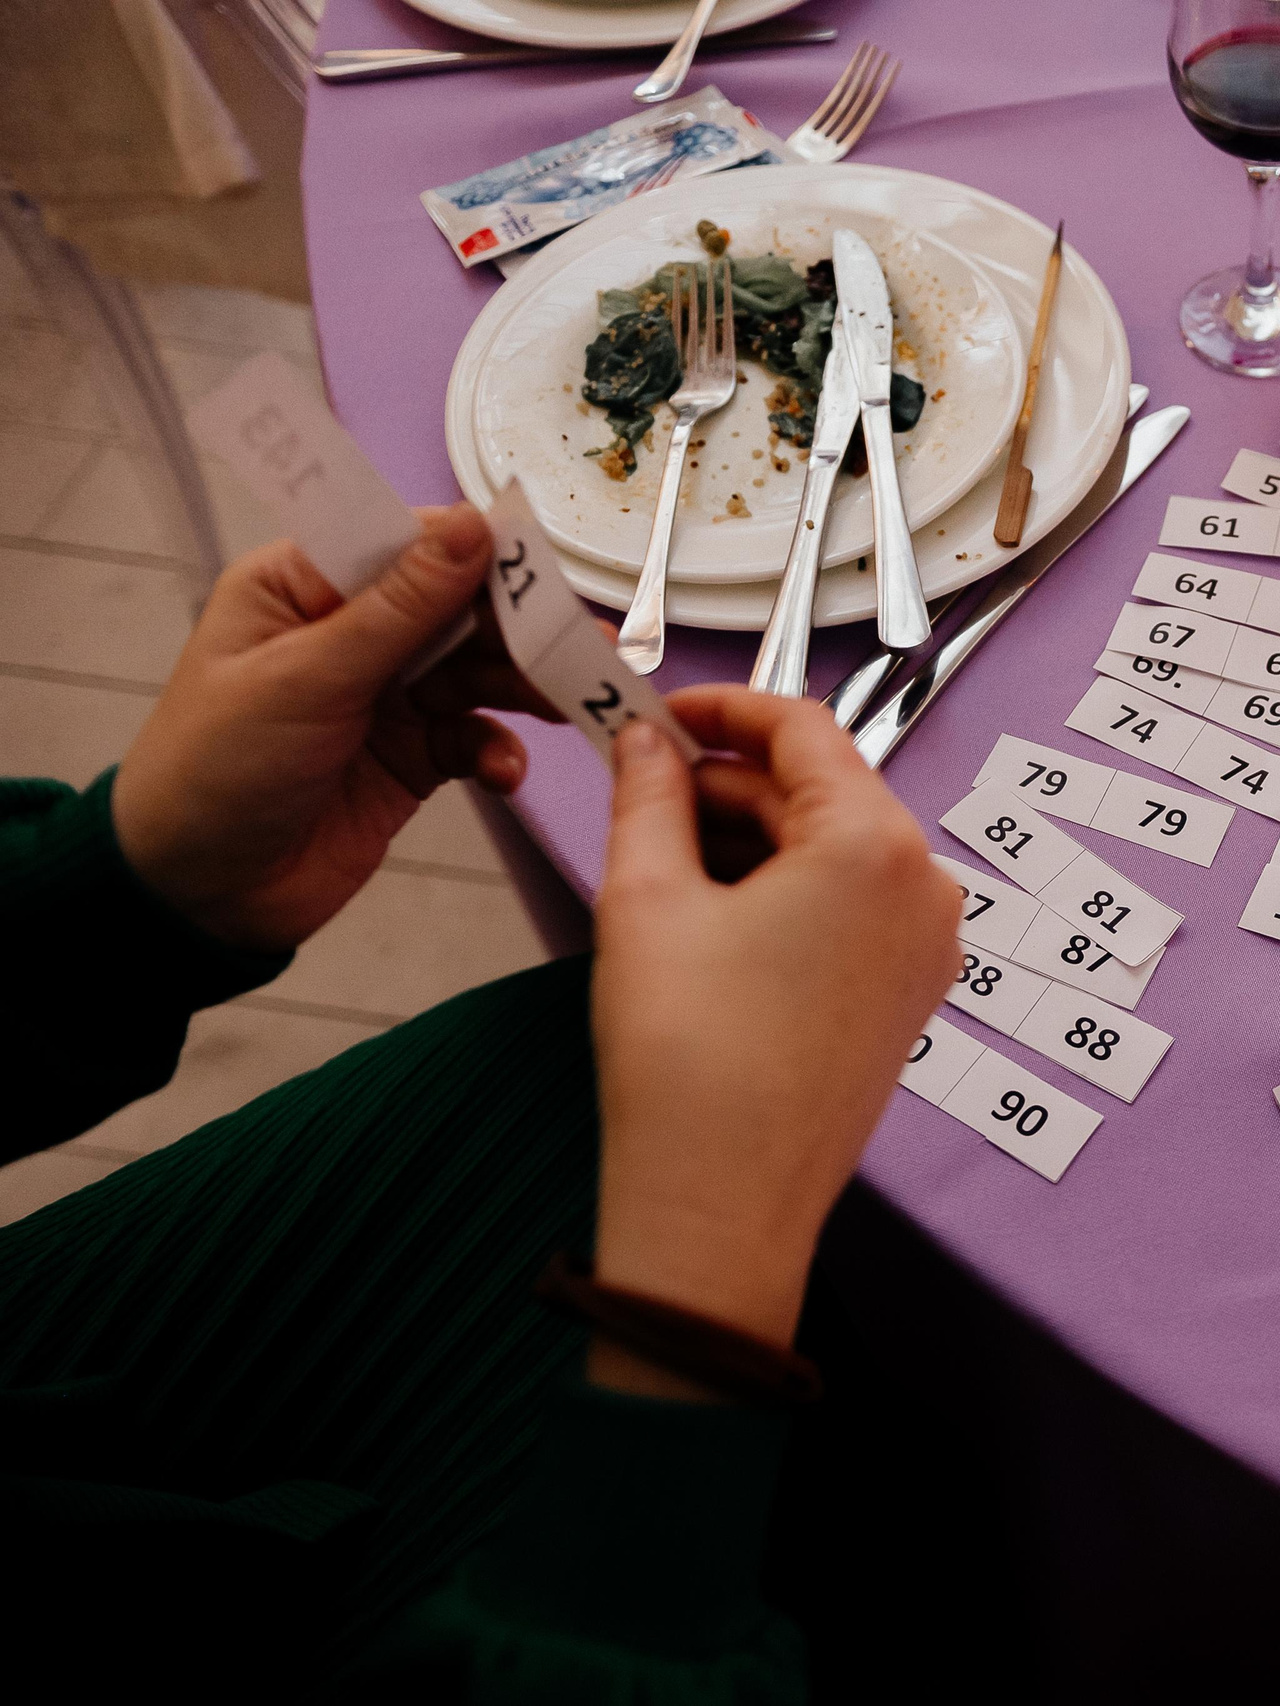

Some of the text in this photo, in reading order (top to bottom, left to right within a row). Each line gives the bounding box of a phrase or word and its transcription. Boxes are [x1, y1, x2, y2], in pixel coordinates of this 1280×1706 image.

[1199, 515, 1239, 539] 61
[1174, 573, 1219, 600] 64
[499, 540, 637, 738] 21 2
[1149, 622, 1196, 649] 67
[1109, 704, 1269, 795] 74 74
[1018, 761, 1188, 836] 79 79
[984, 816, 1132, 935] 81 81
[955, 885, 1114, 973] 7 87
[1064, 1016, 1121, 1061] 88
[990, 1090, 1049, 1137] 90
